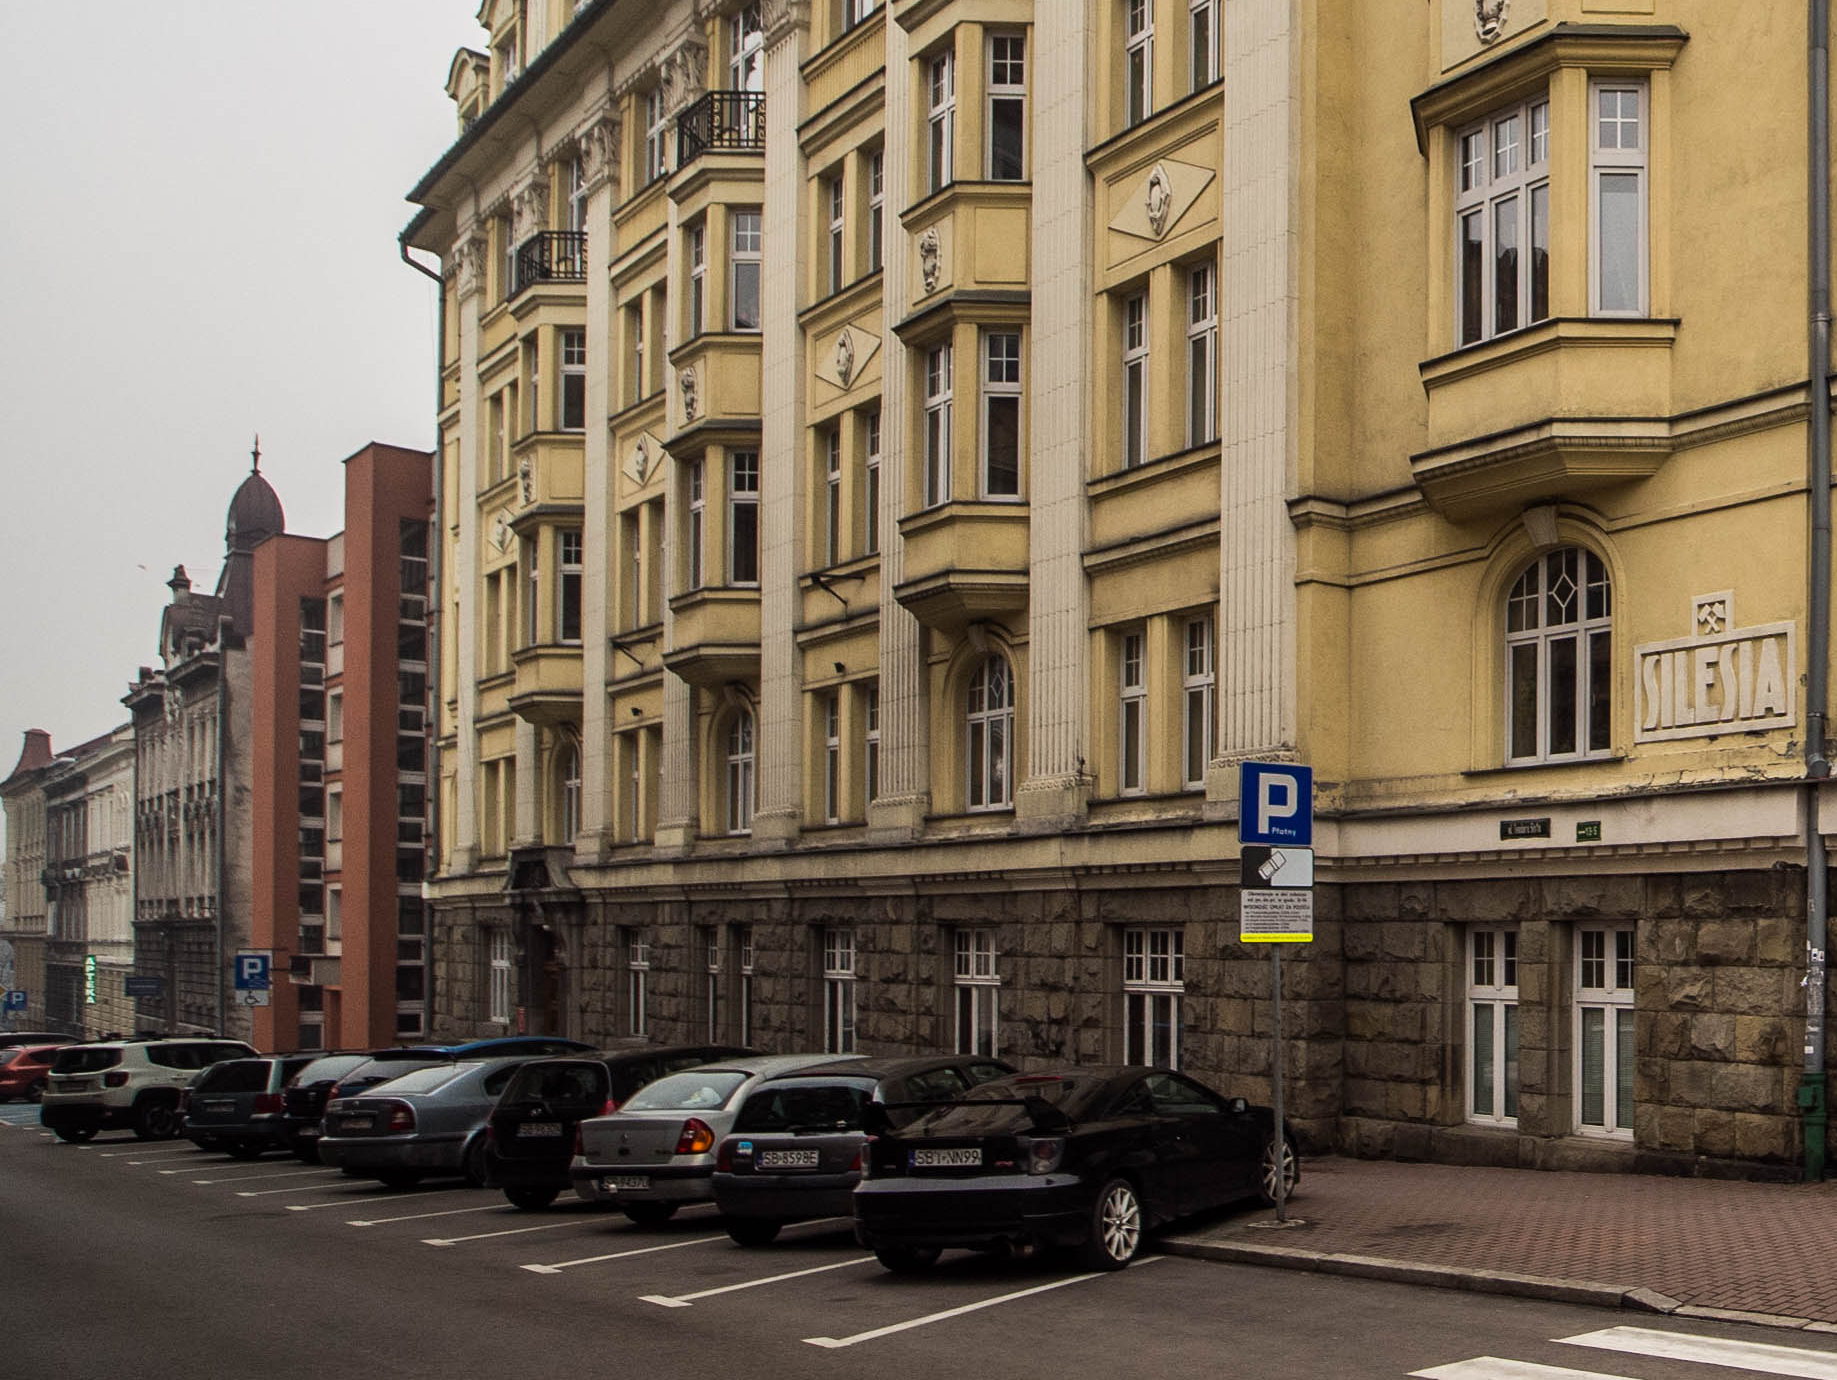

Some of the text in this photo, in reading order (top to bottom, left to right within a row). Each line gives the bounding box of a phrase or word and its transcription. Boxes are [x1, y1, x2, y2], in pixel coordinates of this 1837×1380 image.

[1642, 638, 1787, 729] SILESIA
[1258, 772, 1298, 834] P
[85, 955, 96, 1004] APTEKA
[243, 958, 262, 979] P
